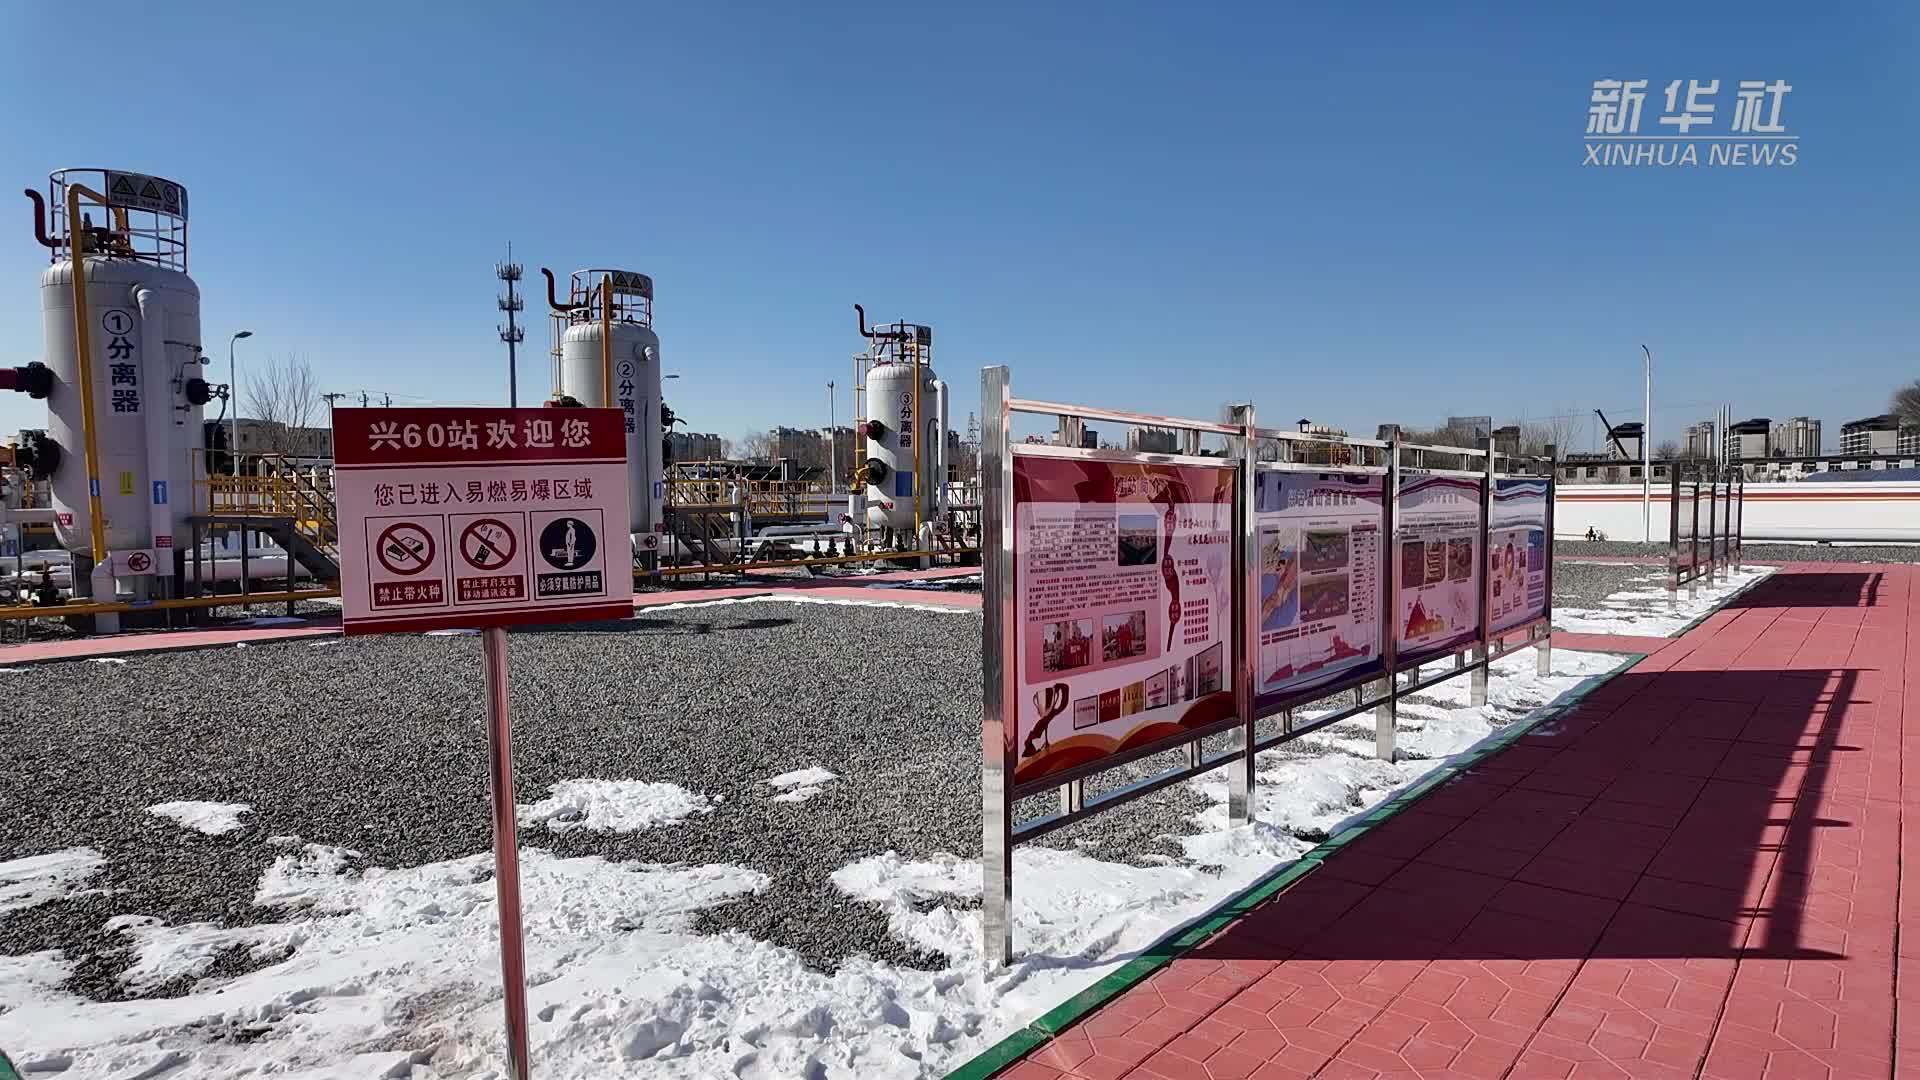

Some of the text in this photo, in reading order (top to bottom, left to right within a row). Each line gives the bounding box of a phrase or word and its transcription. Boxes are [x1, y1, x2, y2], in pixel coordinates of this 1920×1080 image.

[368, 418, 592, 451] 兴60站欢迎您
[374, 478, 593, 506] 您已进入易燃易爆区域
[379, 584, 440, 602] 禁止带火种
[463, 577, 516, 588] 禁止开启无线
